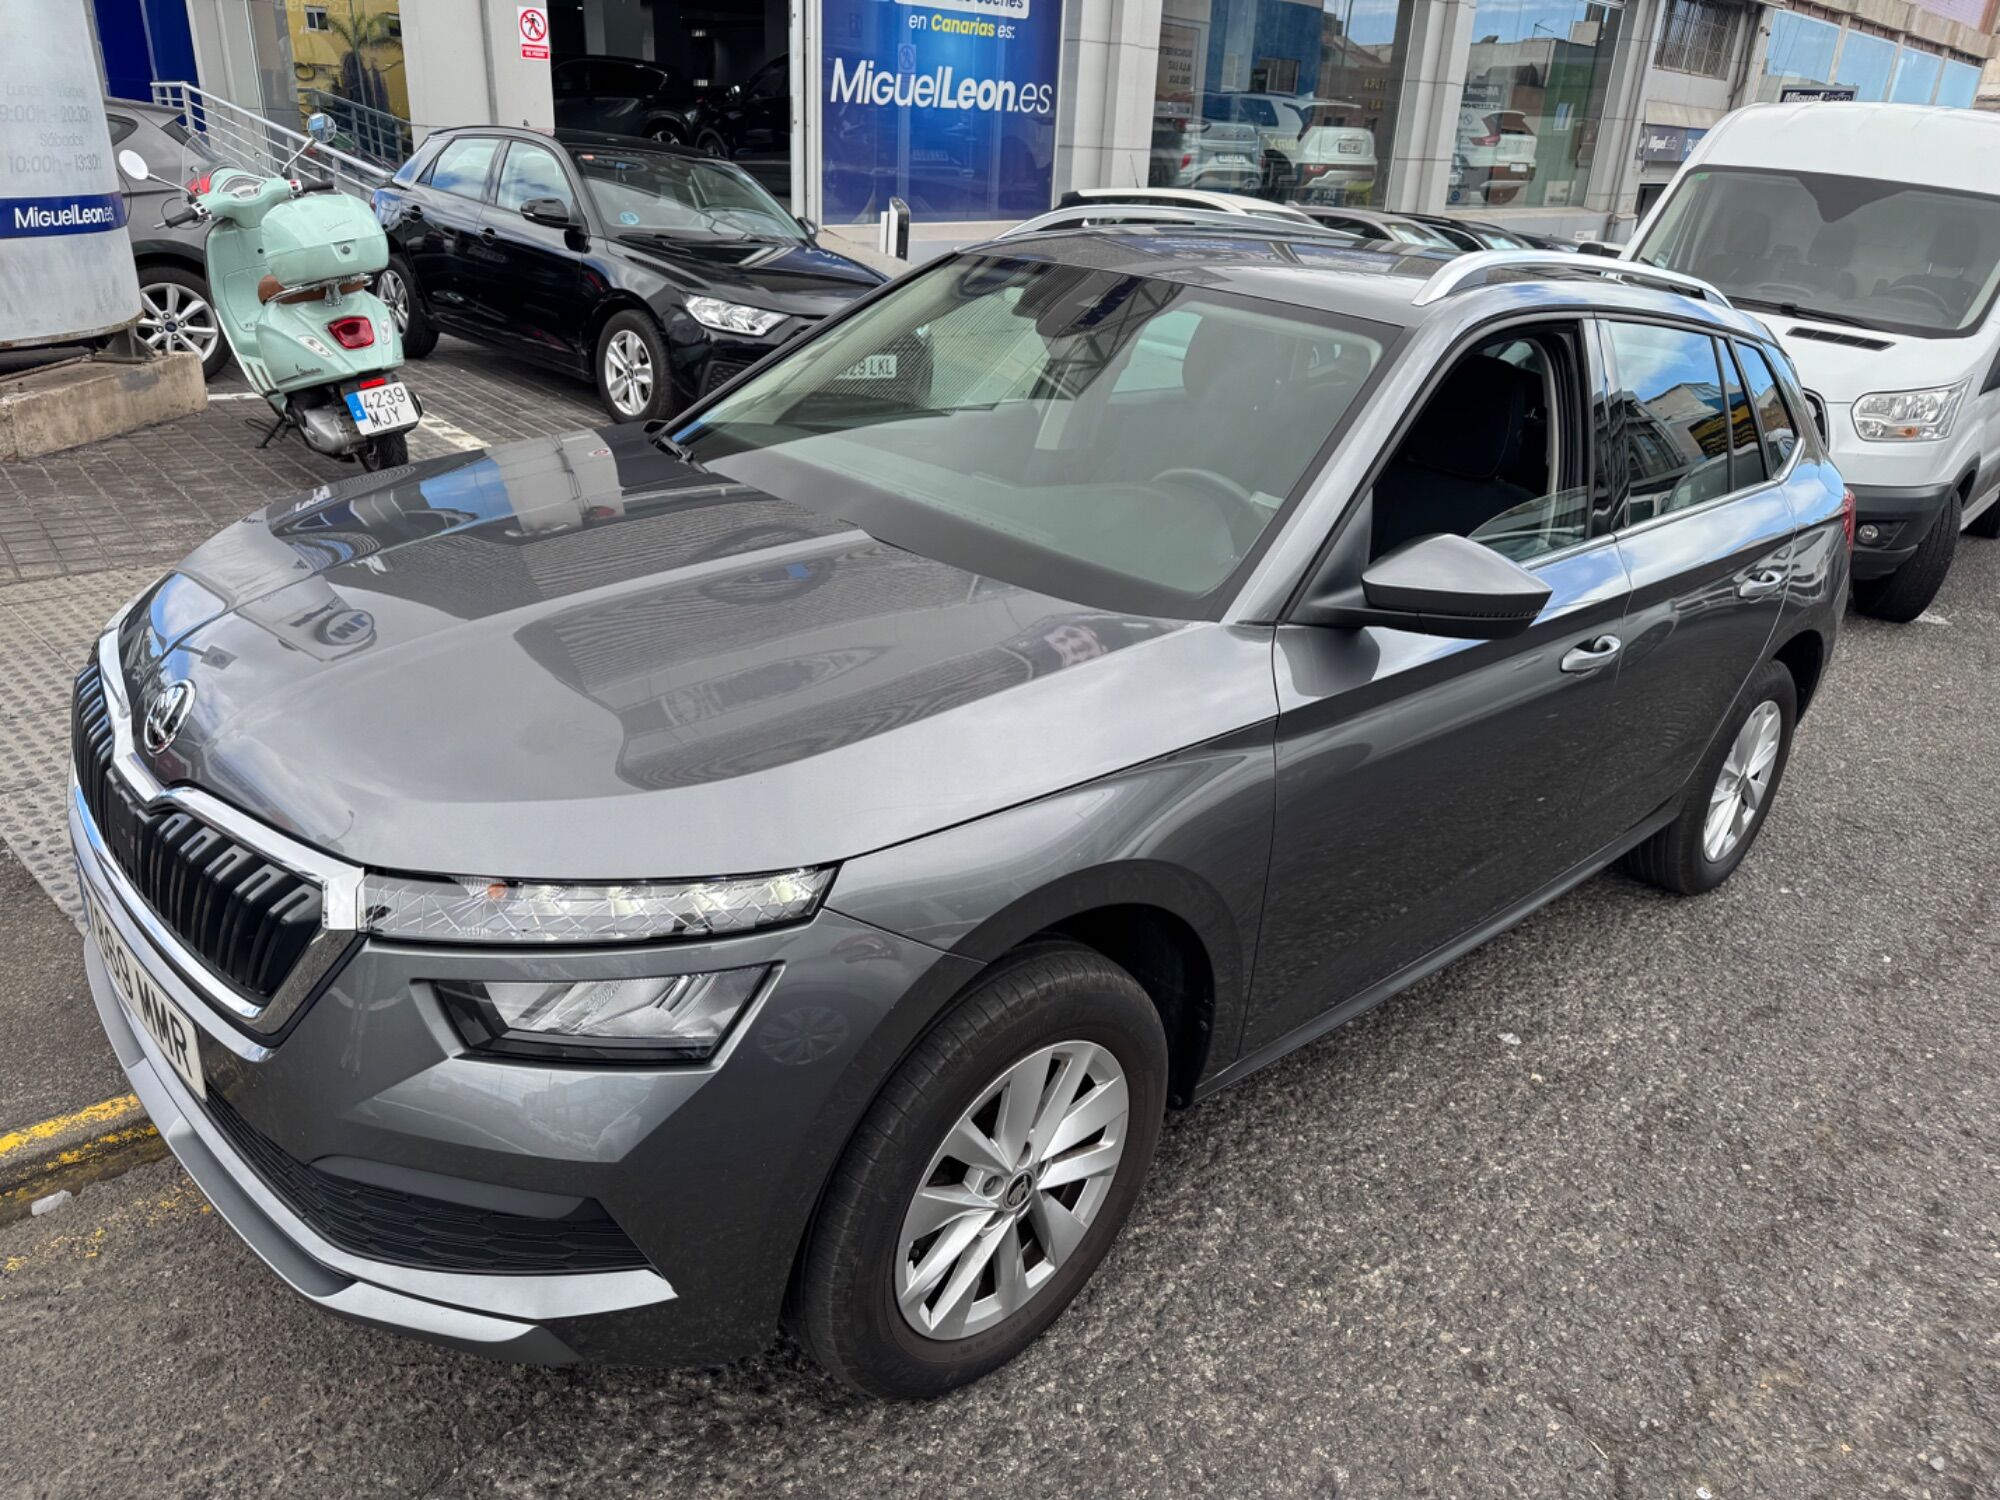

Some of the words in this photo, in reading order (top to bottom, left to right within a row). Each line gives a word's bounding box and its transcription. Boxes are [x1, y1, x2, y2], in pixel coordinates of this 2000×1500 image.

[908, 14, 927, 30] en
[931, 14, 995, 37] Canarias
[8, 153, 62, 174] 10:00h
[74, 152, 103, 173] 13:30h
[363, 386, 406, 409] 4239
[367, 405, 401, 429] MJY
[134, 968, 193, 1079] MMR
